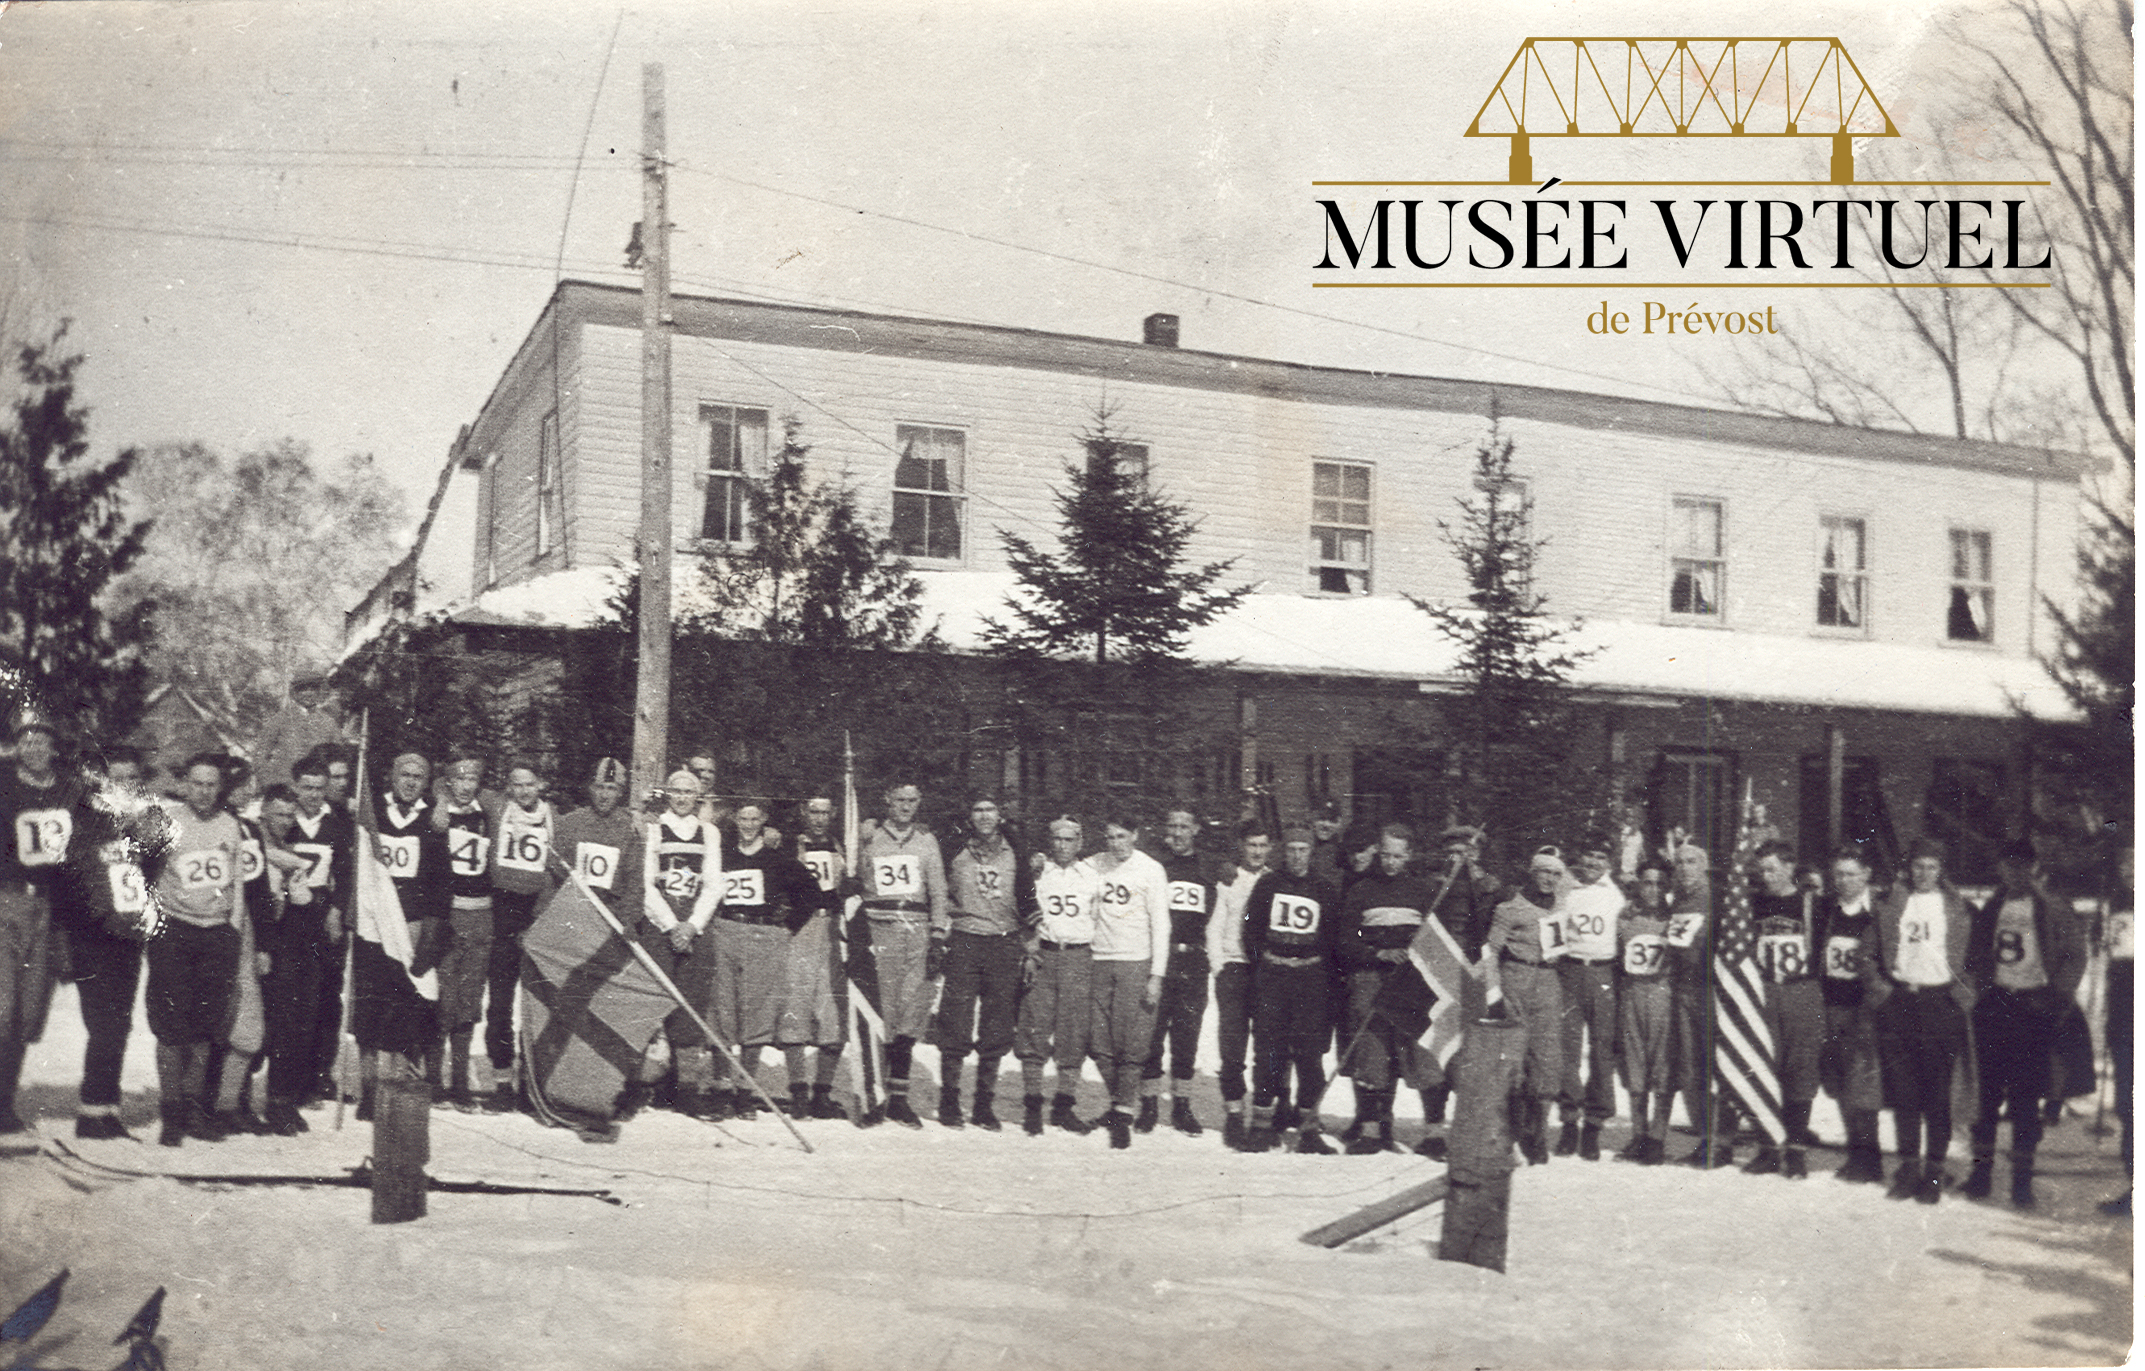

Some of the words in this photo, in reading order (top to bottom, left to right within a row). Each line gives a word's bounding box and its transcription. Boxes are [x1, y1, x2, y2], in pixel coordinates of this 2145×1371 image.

[452, 838, 481, 872] 4
[503, 832, 542, 862] 16
[186, 857, 222, 882] 26
[584, 854, 608, 878] 10
[880, 863, 911, 887] 34
[667, 871, 697, 893] 24
[725, 877, 756, 900] 25
[1102, 882, 1132, 905] 29
[1047, 895, 1080, 918] 35
[1172, 886, 1200, 906] 28
[1275, 901, 1314, 930] 19
[1577, 914, 1605, 936] 20
[1907, 921, 1931, 944] 21
[1631, 942, 1664, 967] 37
[1763, 941, 1804, 977] 18
